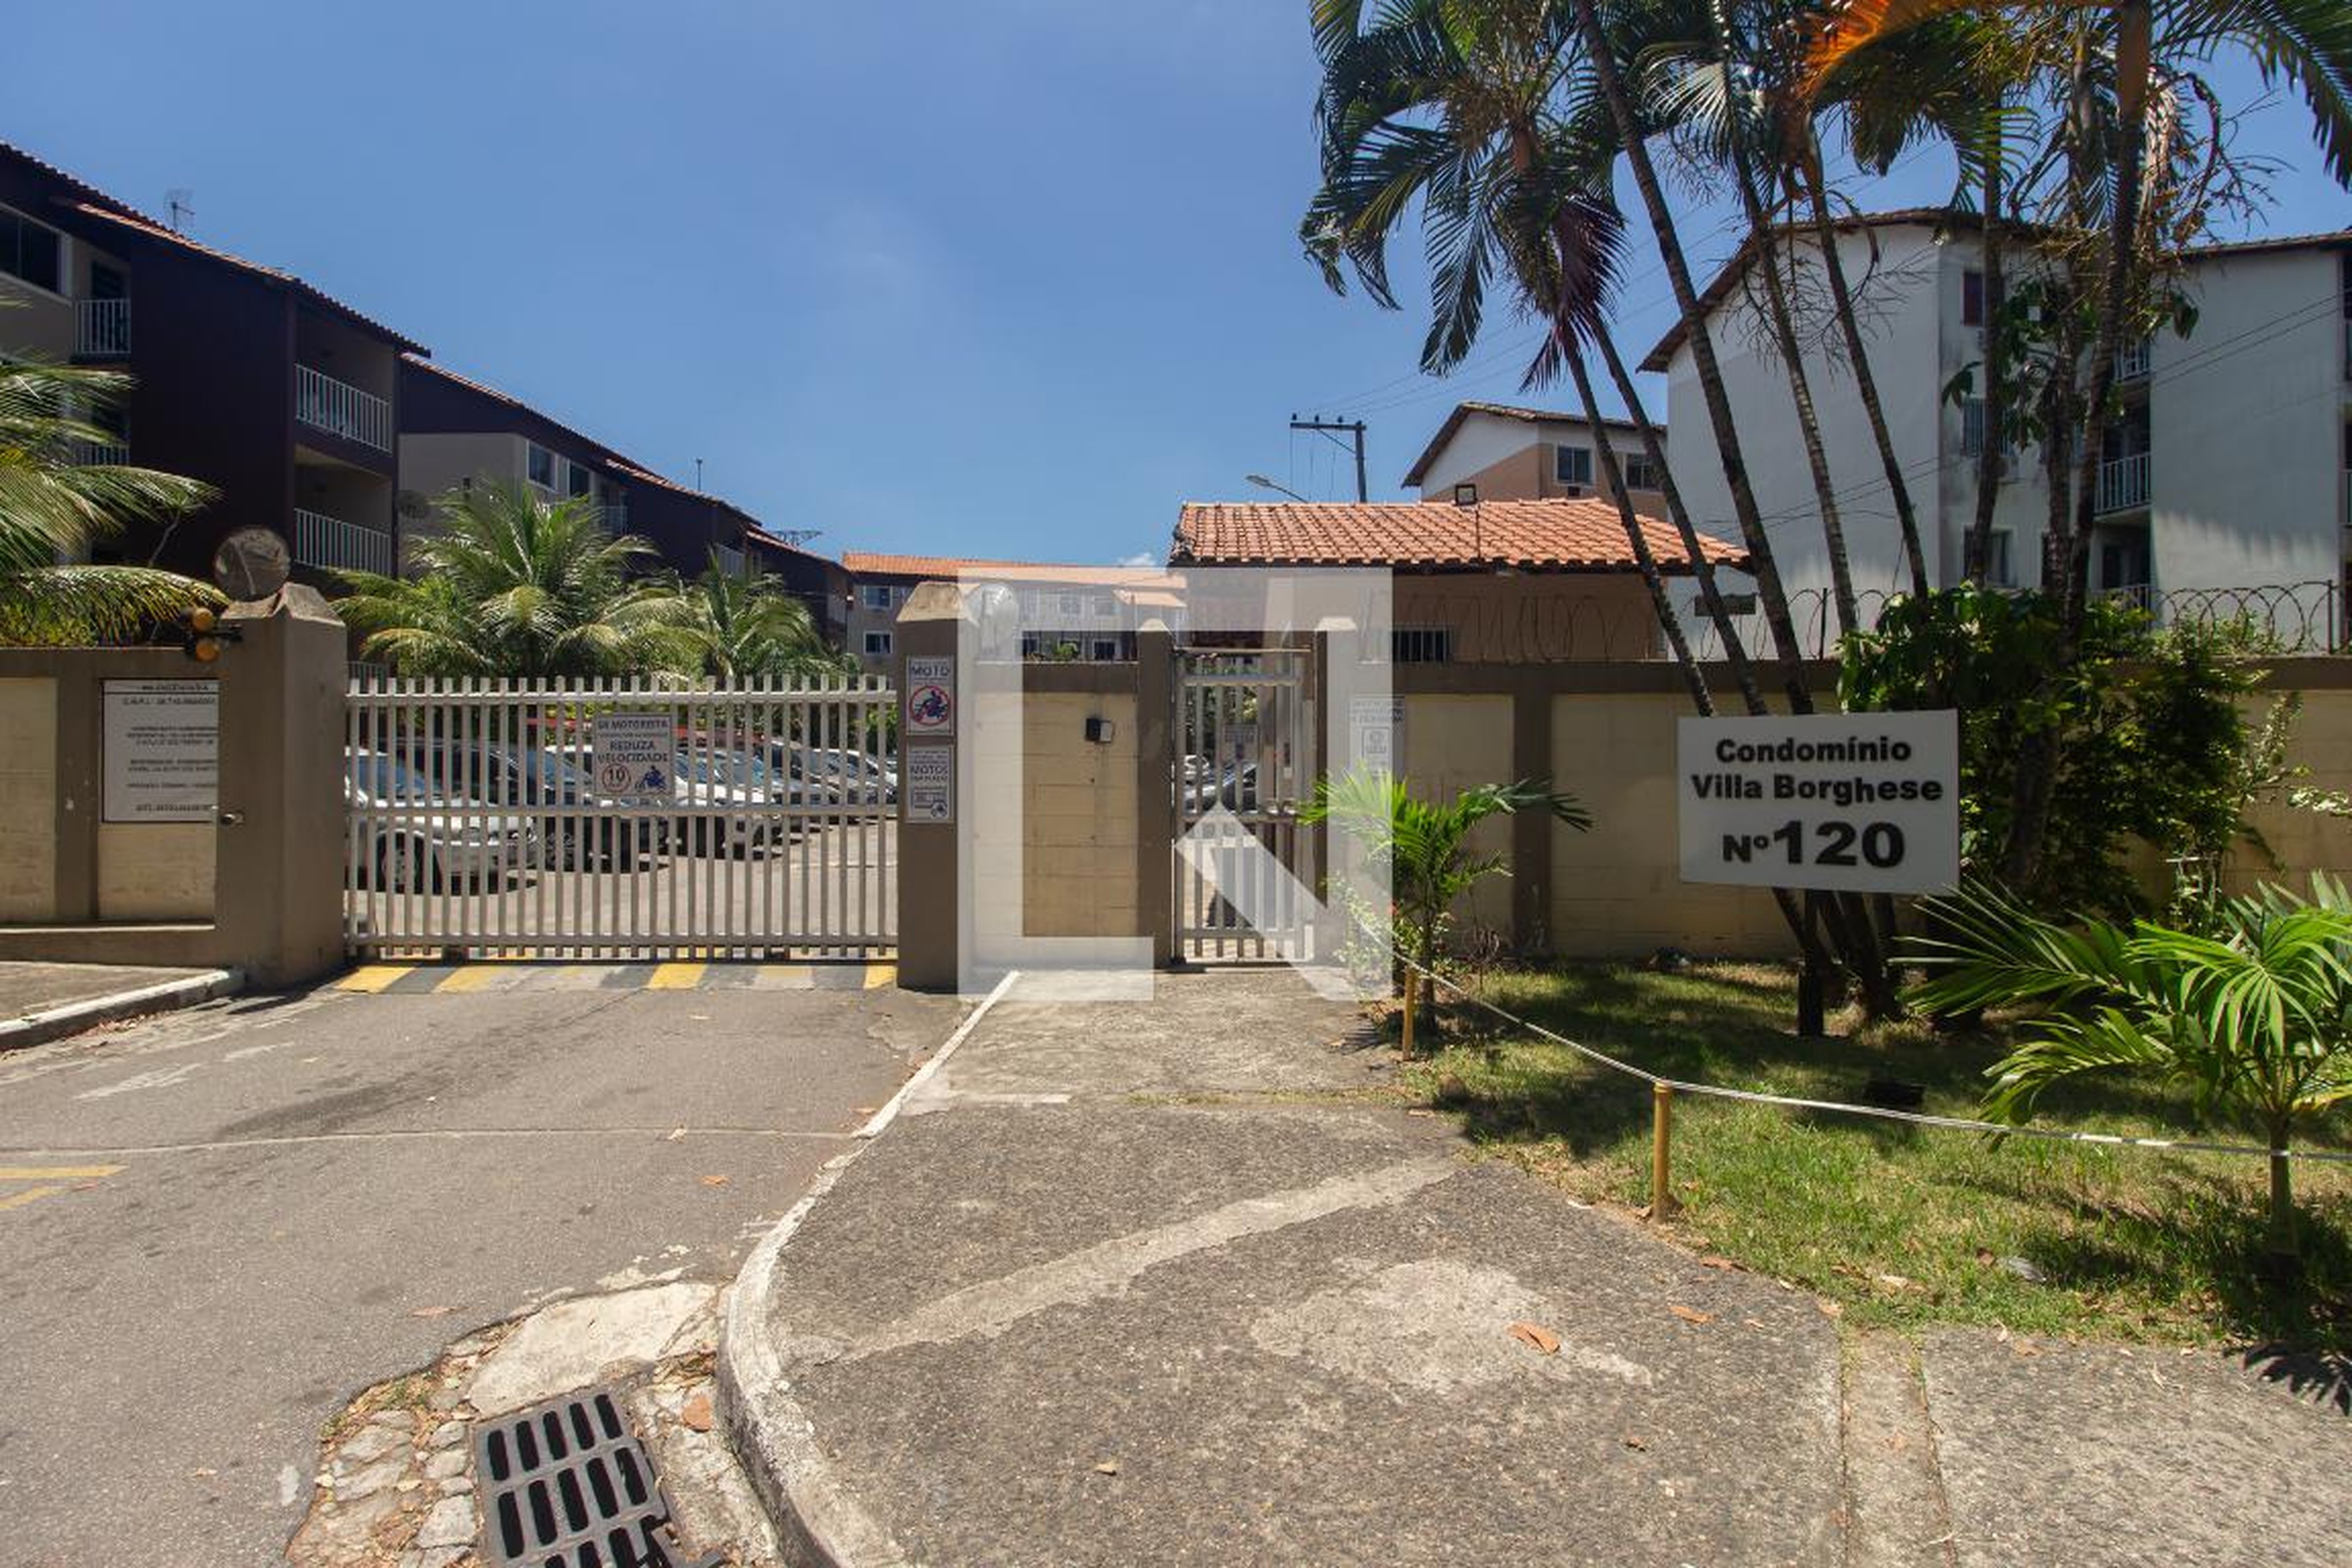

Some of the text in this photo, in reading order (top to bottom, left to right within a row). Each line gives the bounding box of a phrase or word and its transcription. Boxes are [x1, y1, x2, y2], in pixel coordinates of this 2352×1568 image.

[610, 741, 656, 752] REDUZA
[1715, 735, 1912, 763] Condomínio
[1691, 774, 1943, 807] Villa Borghese
